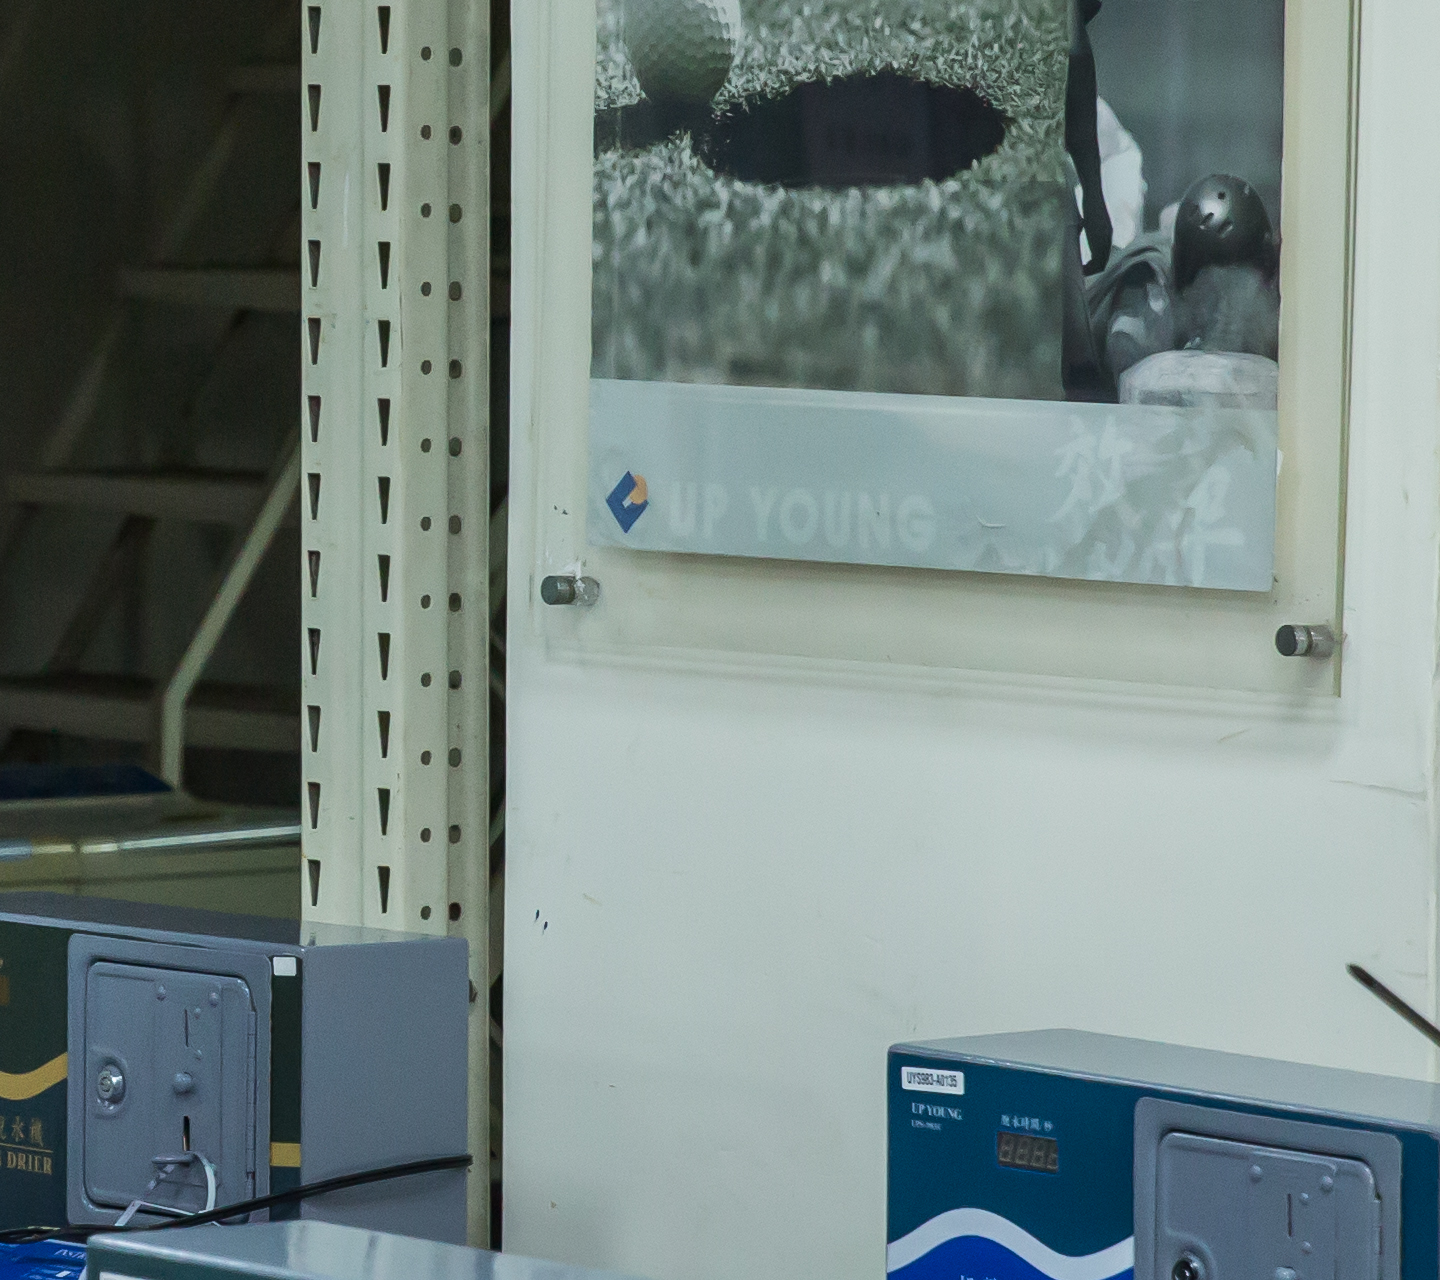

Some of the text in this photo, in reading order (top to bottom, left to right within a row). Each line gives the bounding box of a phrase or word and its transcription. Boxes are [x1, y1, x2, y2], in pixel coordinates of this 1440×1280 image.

[667, 482, 939, 552] UP YOUNG
[911, 1102, 963, 1120] UP YOUNG
[6, 1151, 52, 1175] DRIER
